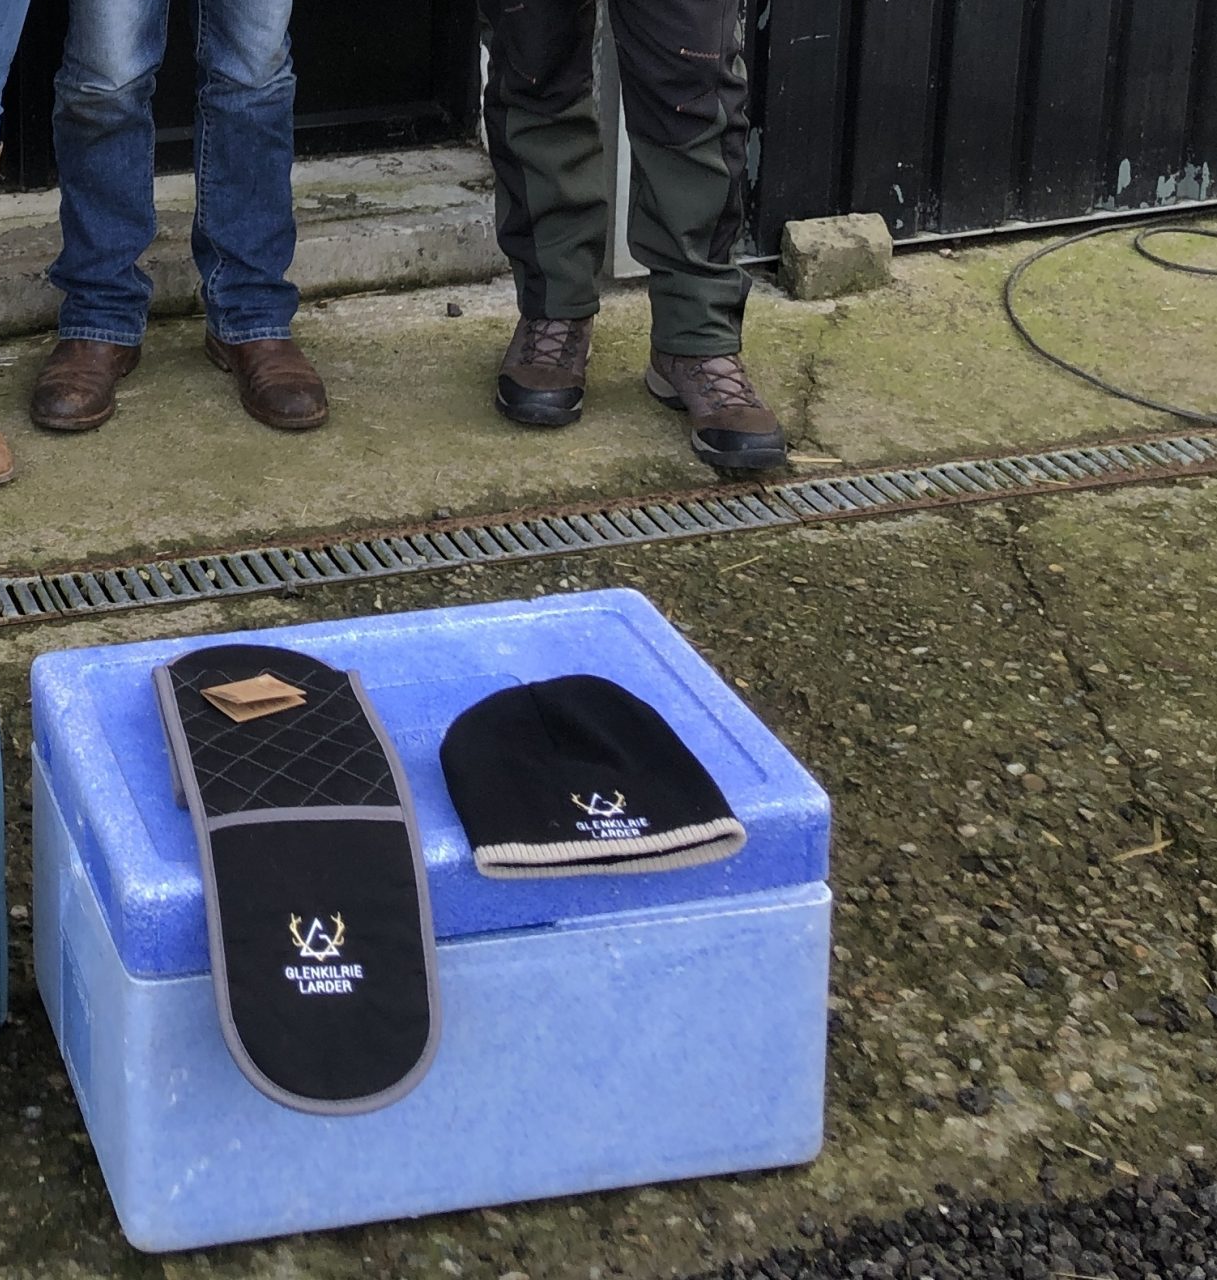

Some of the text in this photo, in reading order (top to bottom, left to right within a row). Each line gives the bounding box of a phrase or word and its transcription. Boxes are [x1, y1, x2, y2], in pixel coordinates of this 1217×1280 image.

[575, 817, 649, 831] GLENKILRIE
[591, 828, 641, 839] LARDER
[285, 964, 363, 980] GLENKILRIE
[299, 980, 353, 994] LARDER
